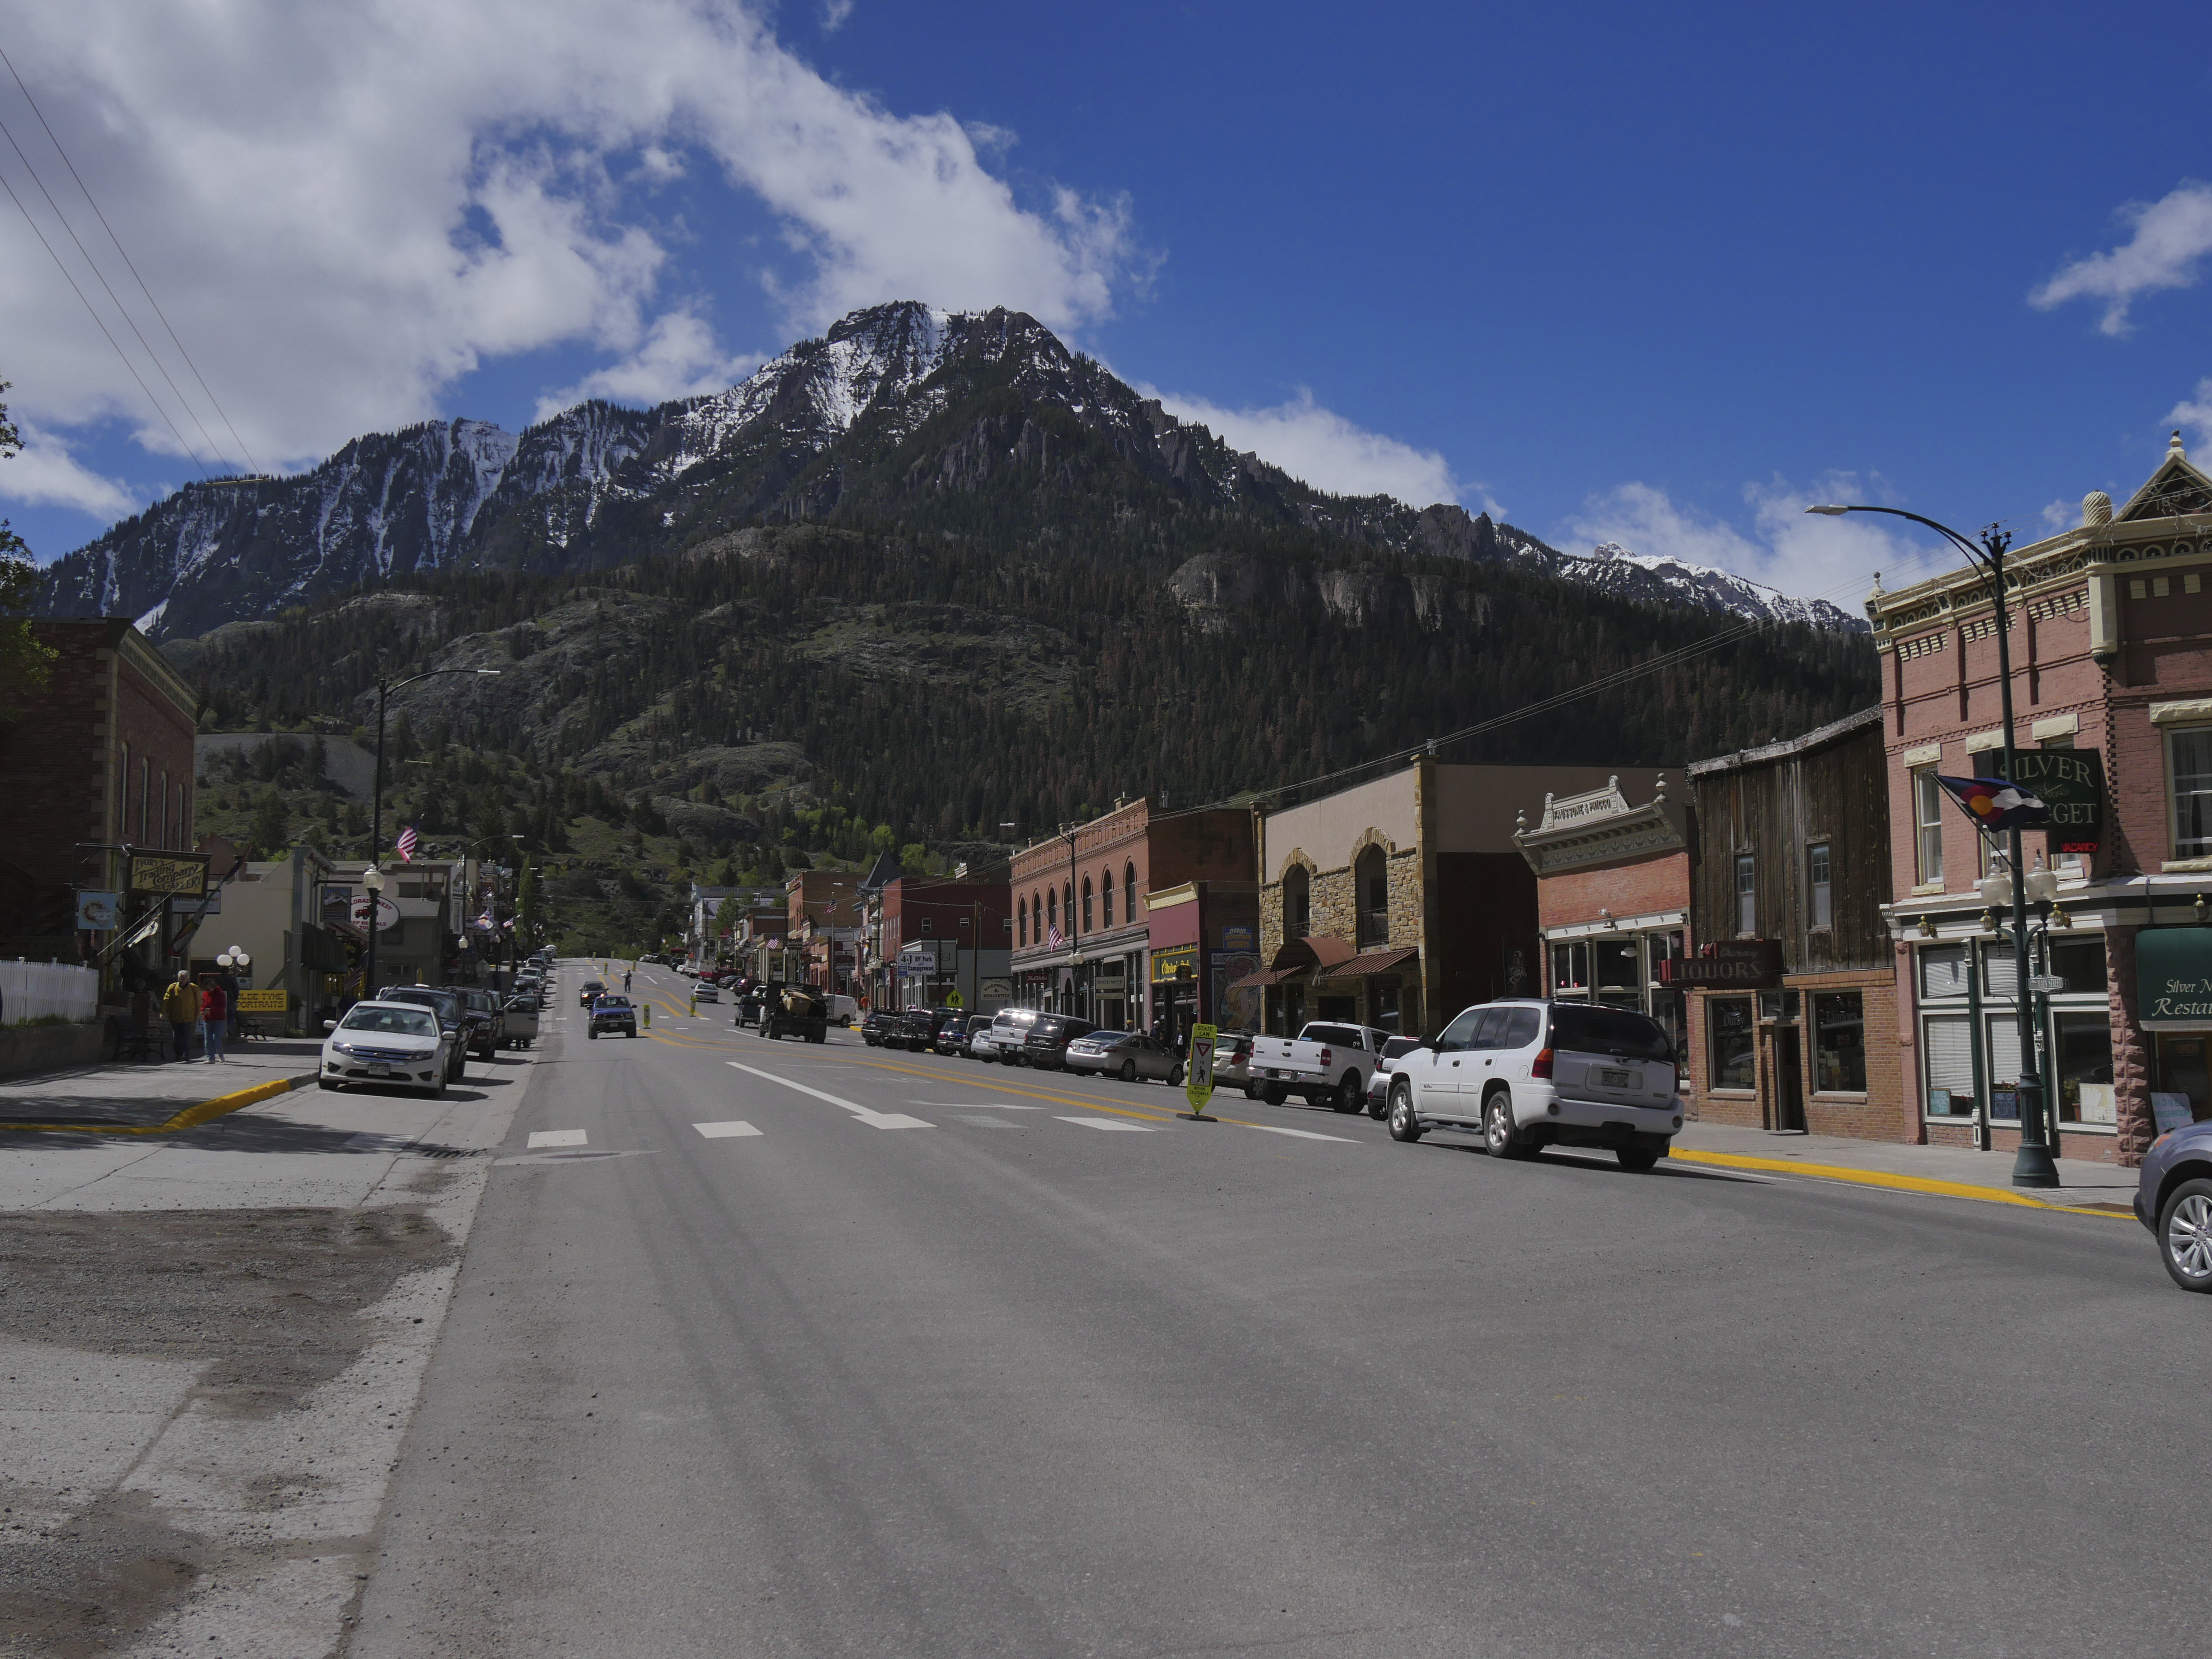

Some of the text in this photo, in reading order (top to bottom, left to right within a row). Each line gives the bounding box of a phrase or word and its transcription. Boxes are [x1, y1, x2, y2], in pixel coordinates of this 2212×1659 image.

[1554, 797, 1611, 820] FAUSSONE & PRICCO
[2061, 842, 2099, 852] VACANCY
[138, 864, 175, 884] Trading
[153, 864, 199, 887] Company
[162, 874, 202, 891] GALLERY
[901, 955, 912, 964] 4-J
[1680, 961, 1762, 980] IQUORS
[984, 984, 1010, 992] HARDWARE
[2037, 979, 2047, 988] MAIN
[2048, 978, 2061, 987] STREET
[2166, 979, 2196, 993] Silver
[1826, 1010, 1858, 1023] Liquors
